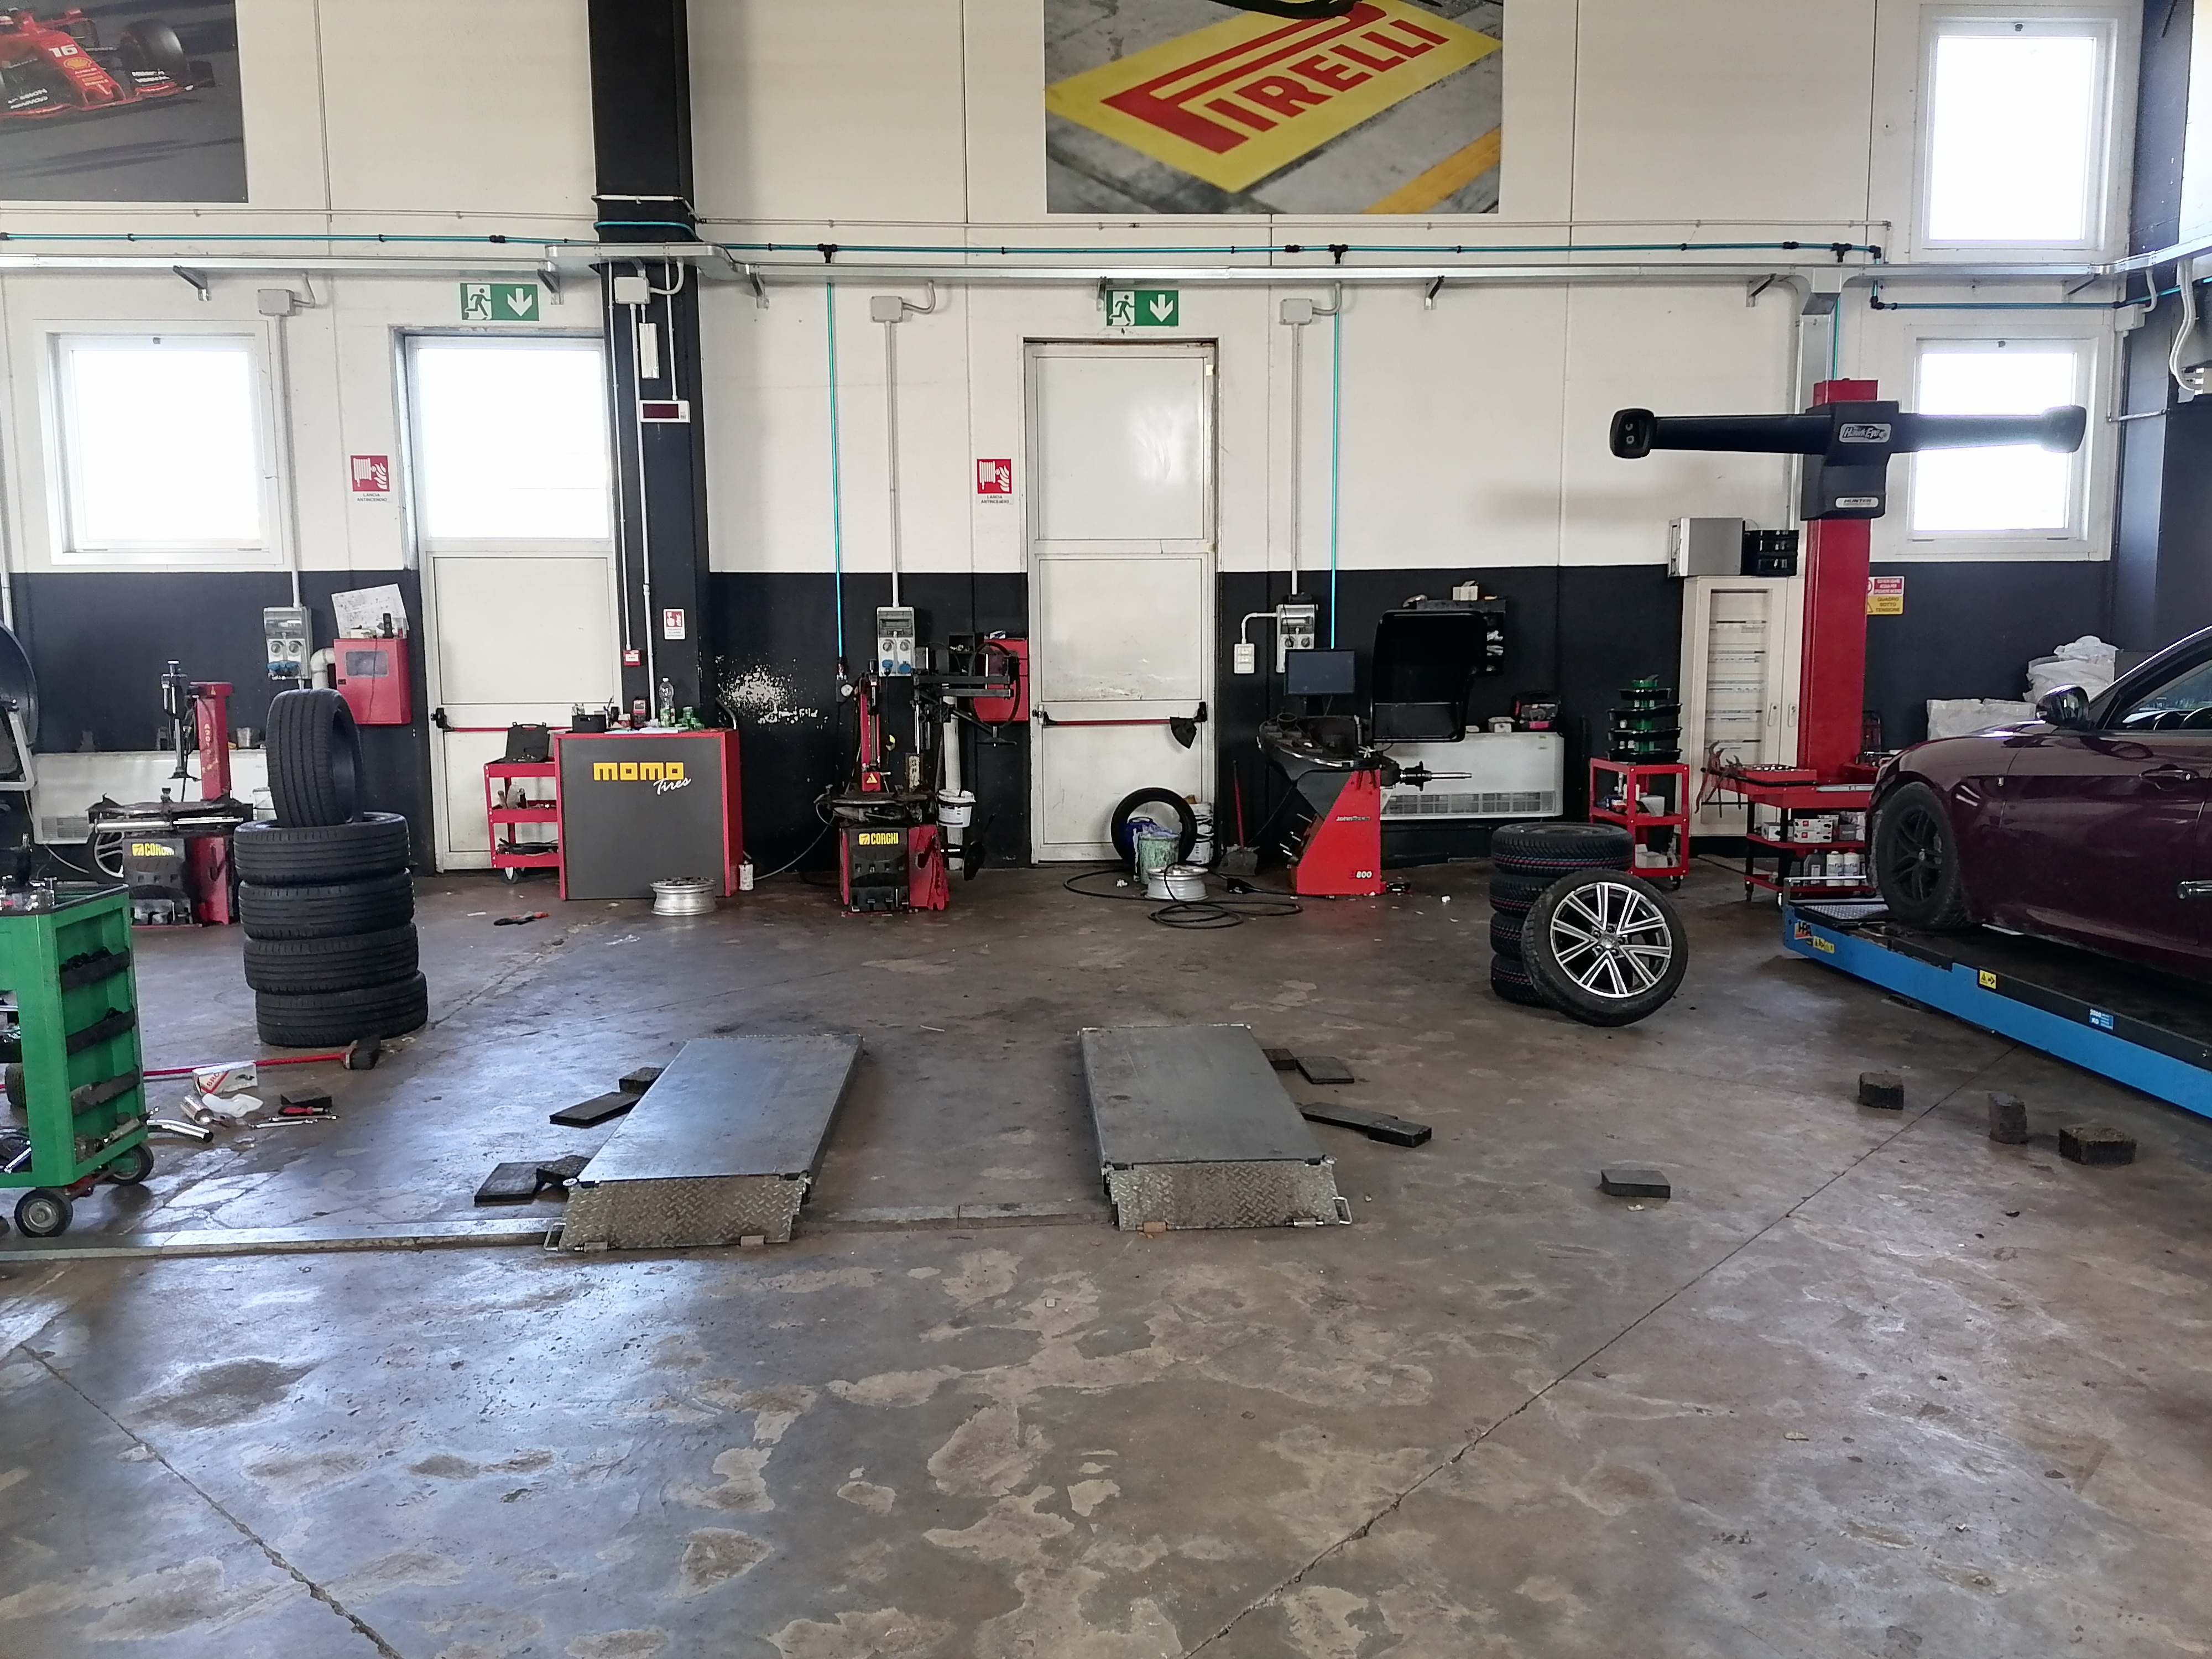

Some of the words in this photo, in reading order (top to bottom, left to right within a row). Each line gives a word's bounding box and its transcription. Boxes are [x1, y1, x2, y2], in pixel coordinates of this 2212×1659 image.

[49, 44, 78, 57] 16
[1100, 2, 1451, 154] PIRELLI
[653, 778, 691, 795] Tires
[870, 832, 899, 844] CORGHI
